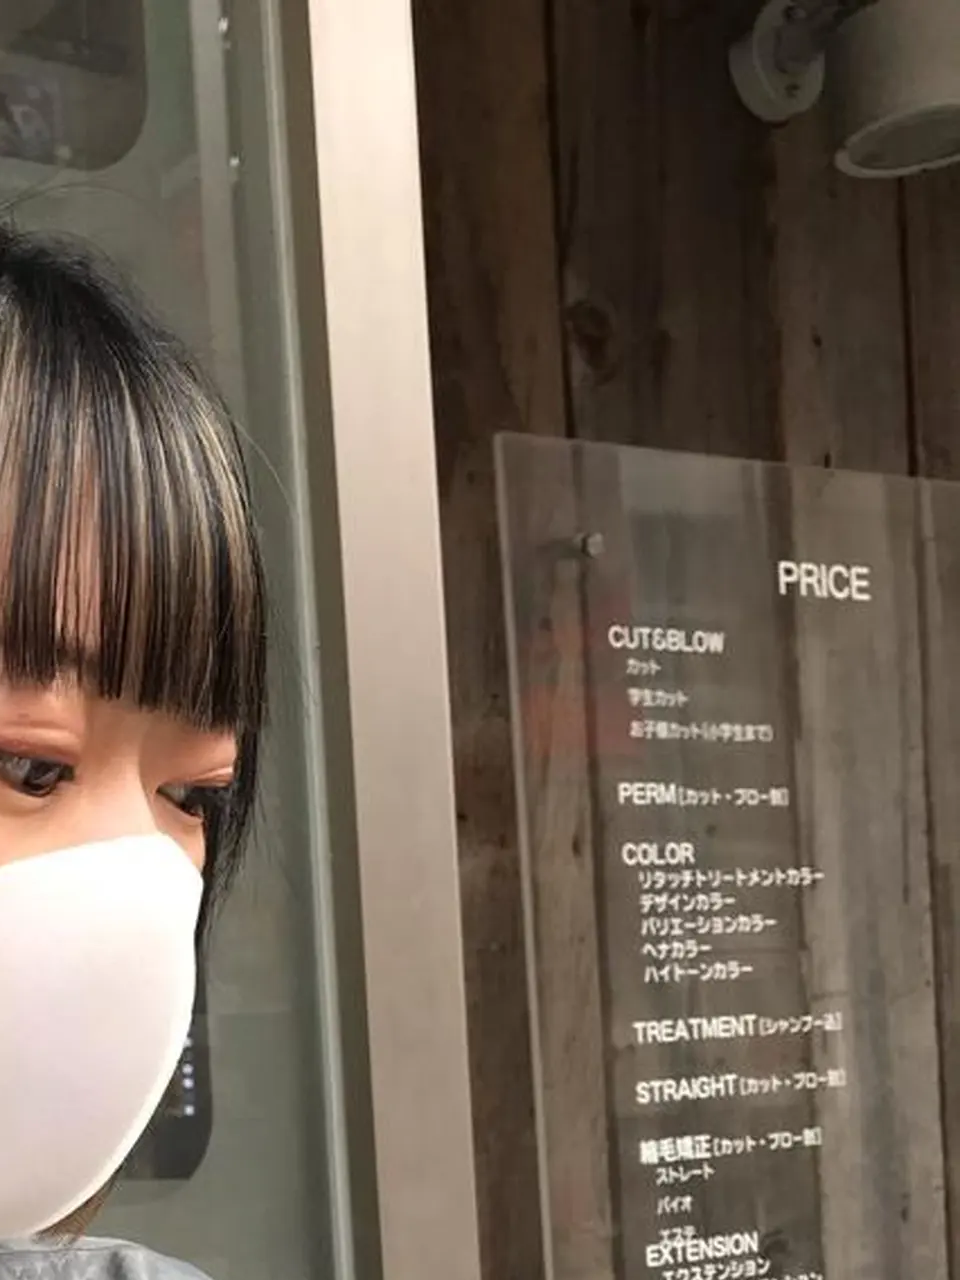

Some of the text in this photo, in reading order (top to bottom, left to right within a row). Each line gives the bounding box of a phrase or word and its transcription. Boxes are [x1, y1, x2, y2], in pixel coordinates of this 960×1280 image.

[777, 560, 872, 601] PRICE
[607, 624, 726, 653] CUT&BLOW
[617, 781, 677, 805] PERM
[621, 842, 696, 866] COLOR
[639, 866, 826, 890] リタッチトリートメントカラー
[640, 892, 737, 914] デザインカラー
[640, 914, 779, 936] バリエーションカラー
[642, 939, 713, 960] ヘナカラー
[644, 960, 754, 983] ハイトーンカラー
[633, 1013, 757, 1044] TREATMENT
[635, 1073, 738, 1104] STRAIGHT
[655, 1161, 716, 1186] ストレート
[645, 1231, 760, 1267] EXTENSION
